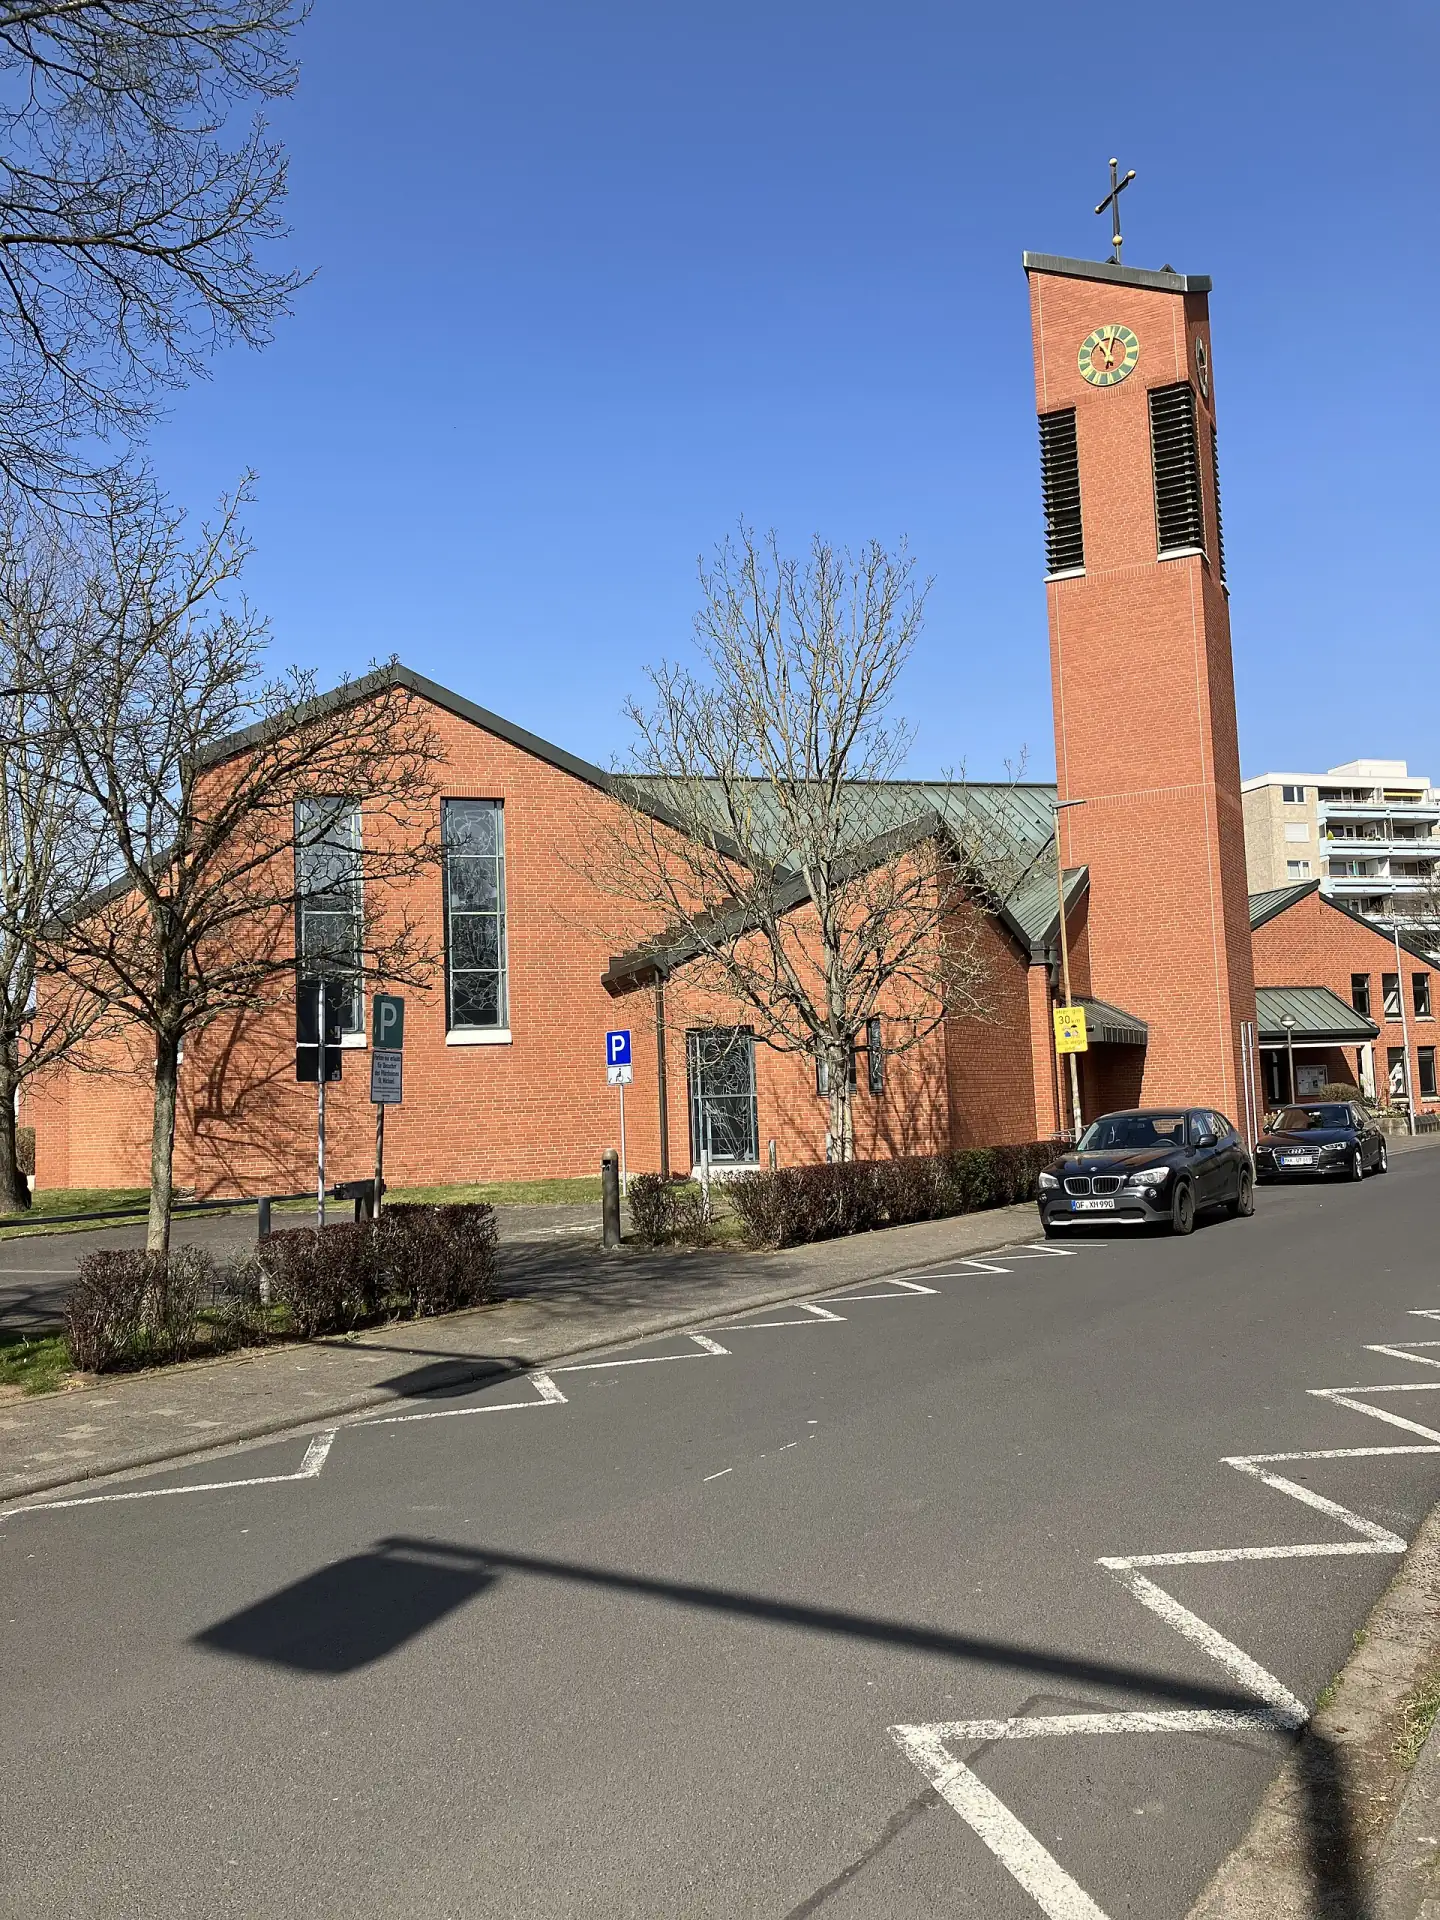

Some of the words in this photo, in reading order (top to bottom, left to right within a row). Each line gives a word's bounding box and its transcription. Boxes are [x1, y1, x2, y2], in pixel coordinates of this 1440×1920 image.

[380, 1002, 397, 1041] P
[1058, 1015, 1070, 1024] 30
[611, 1035, 625, 1061] P
[1075, 1201, 1084, 1209] OF
[1099, 1200, 1114, 1208] 990
